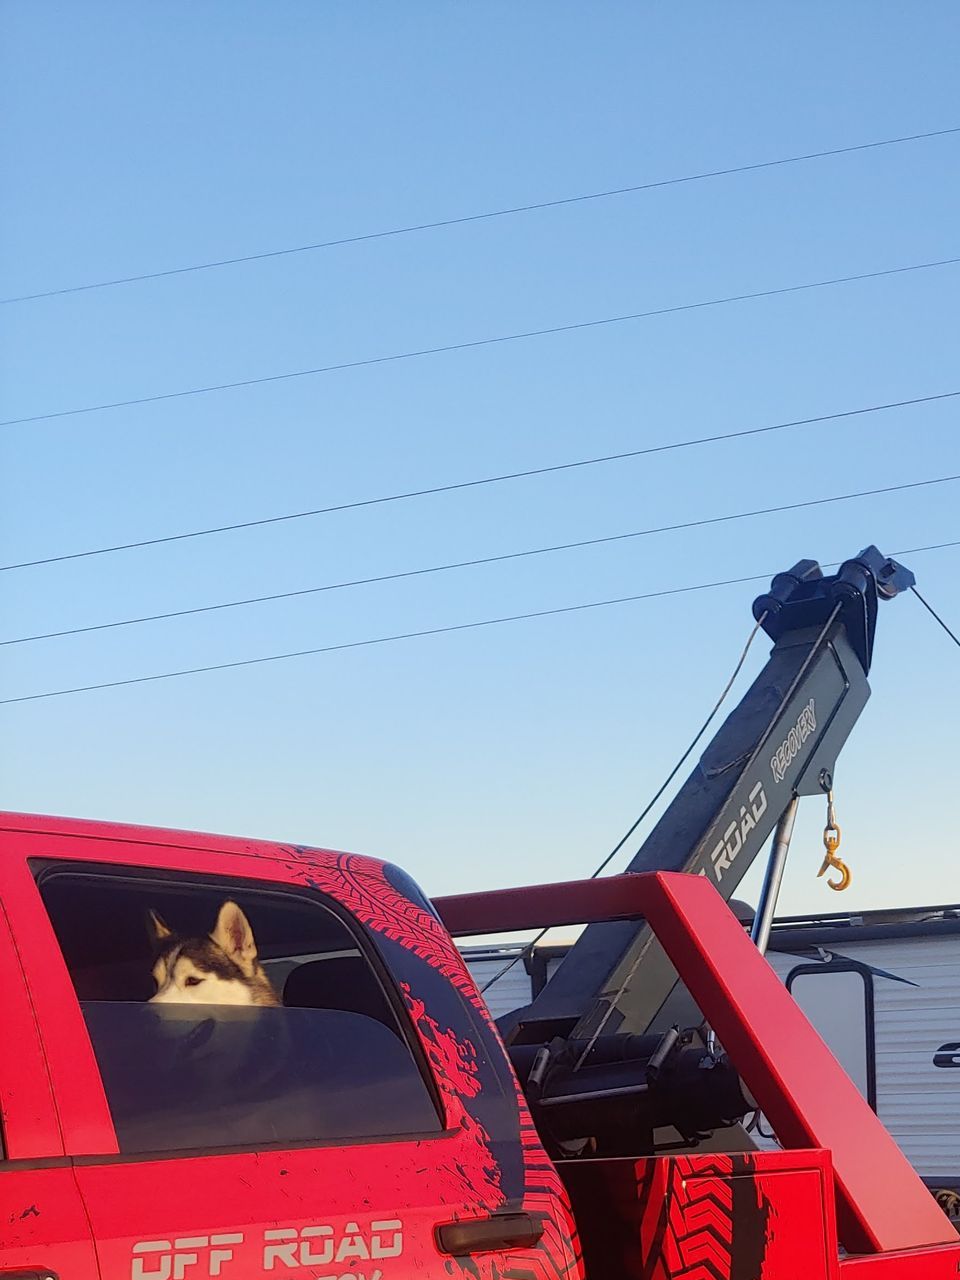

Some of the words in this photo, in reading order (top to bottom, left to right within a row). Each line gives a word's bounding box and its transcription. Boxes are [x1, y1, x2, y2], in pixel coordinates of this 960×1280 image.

[711, 781, 769, 882] ROAD
[770, 698, 816, 784] RECOVERY
[263, 1219, 403, 1270] ROAD
